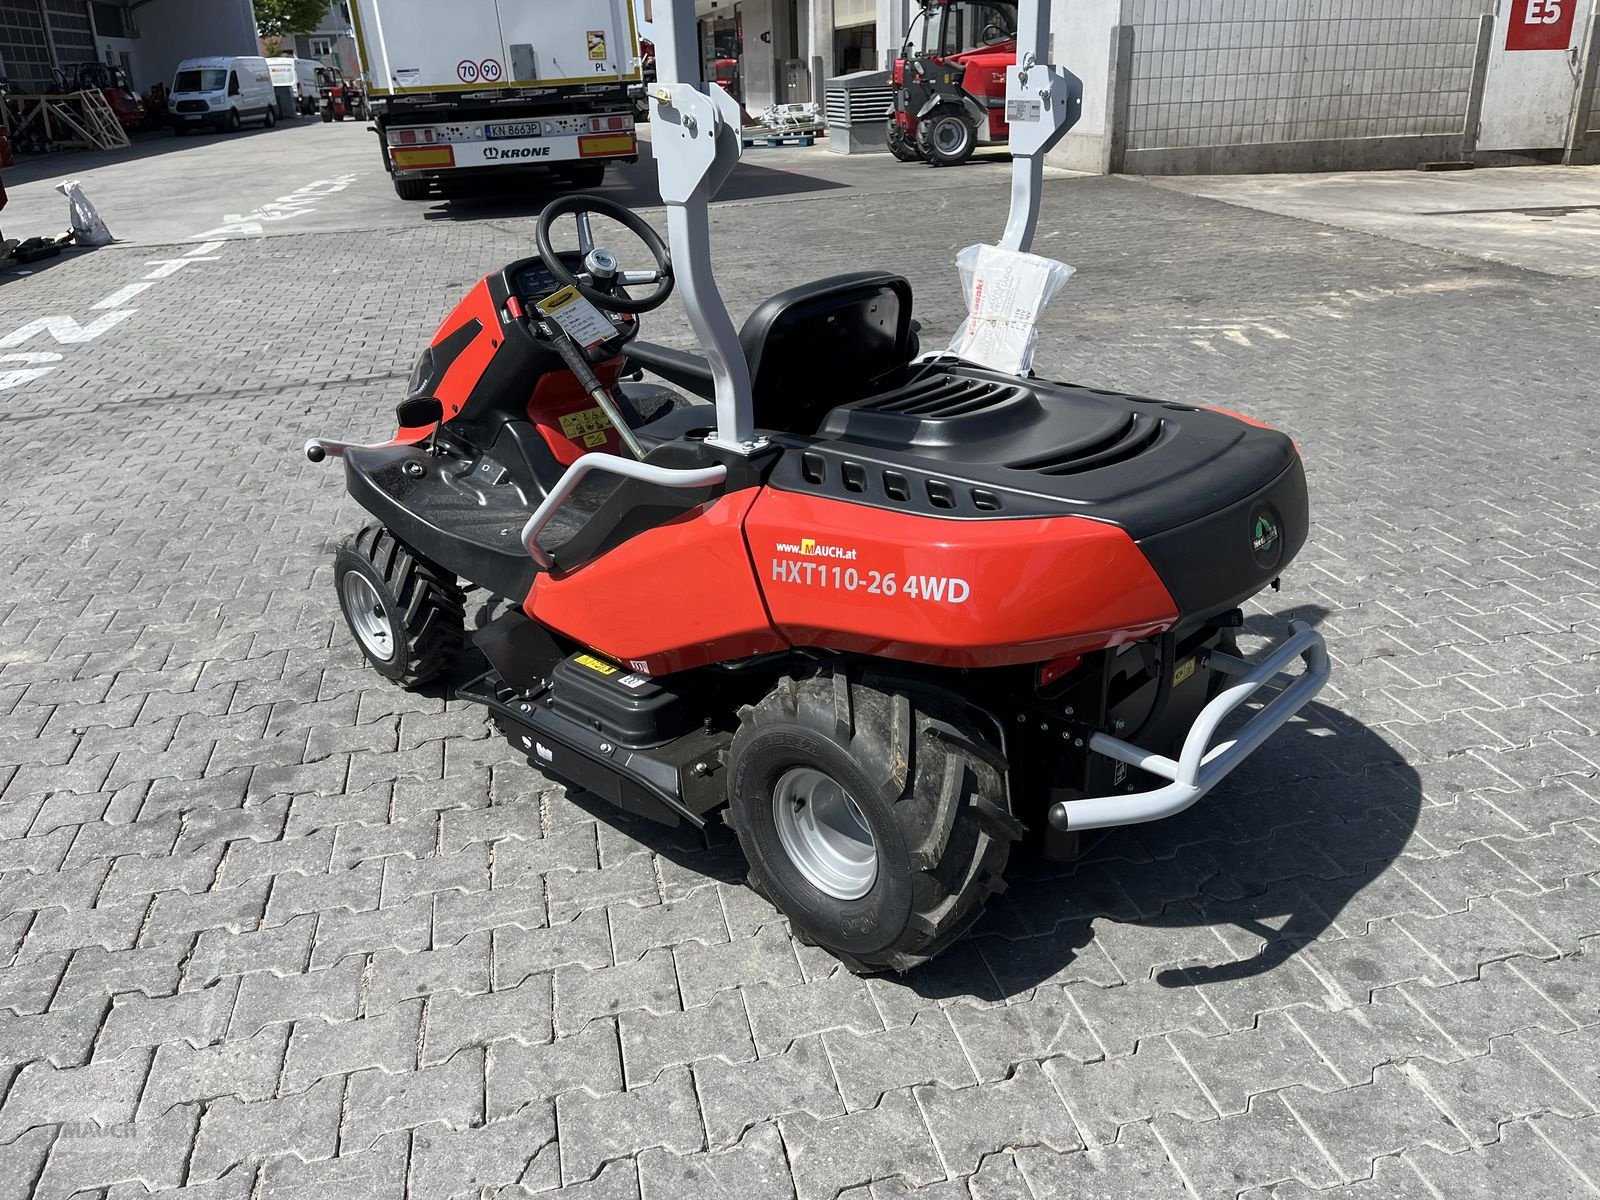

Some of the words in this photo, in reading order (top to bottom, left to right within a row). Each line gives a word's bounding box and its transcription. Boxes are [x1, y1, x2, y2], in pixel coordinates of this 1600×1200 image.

[1525, 0, 1561, 24] E5
[460, 65, 475, 78] 70
[483, 64, 498, 77] 90
[595, 62, 606, 72] PL
[491, 125, 506, 137] KN
[508, 123, 538, 135] 8663P
[501, 146, 550, 159] KRONE
[968, 279, 984, 336] aasaki
[776, 541, 857, 560] www.MAUCH.at
[772, 559, 897, 596] HXT110-26
[903, 575, 970, 603] 4WD
